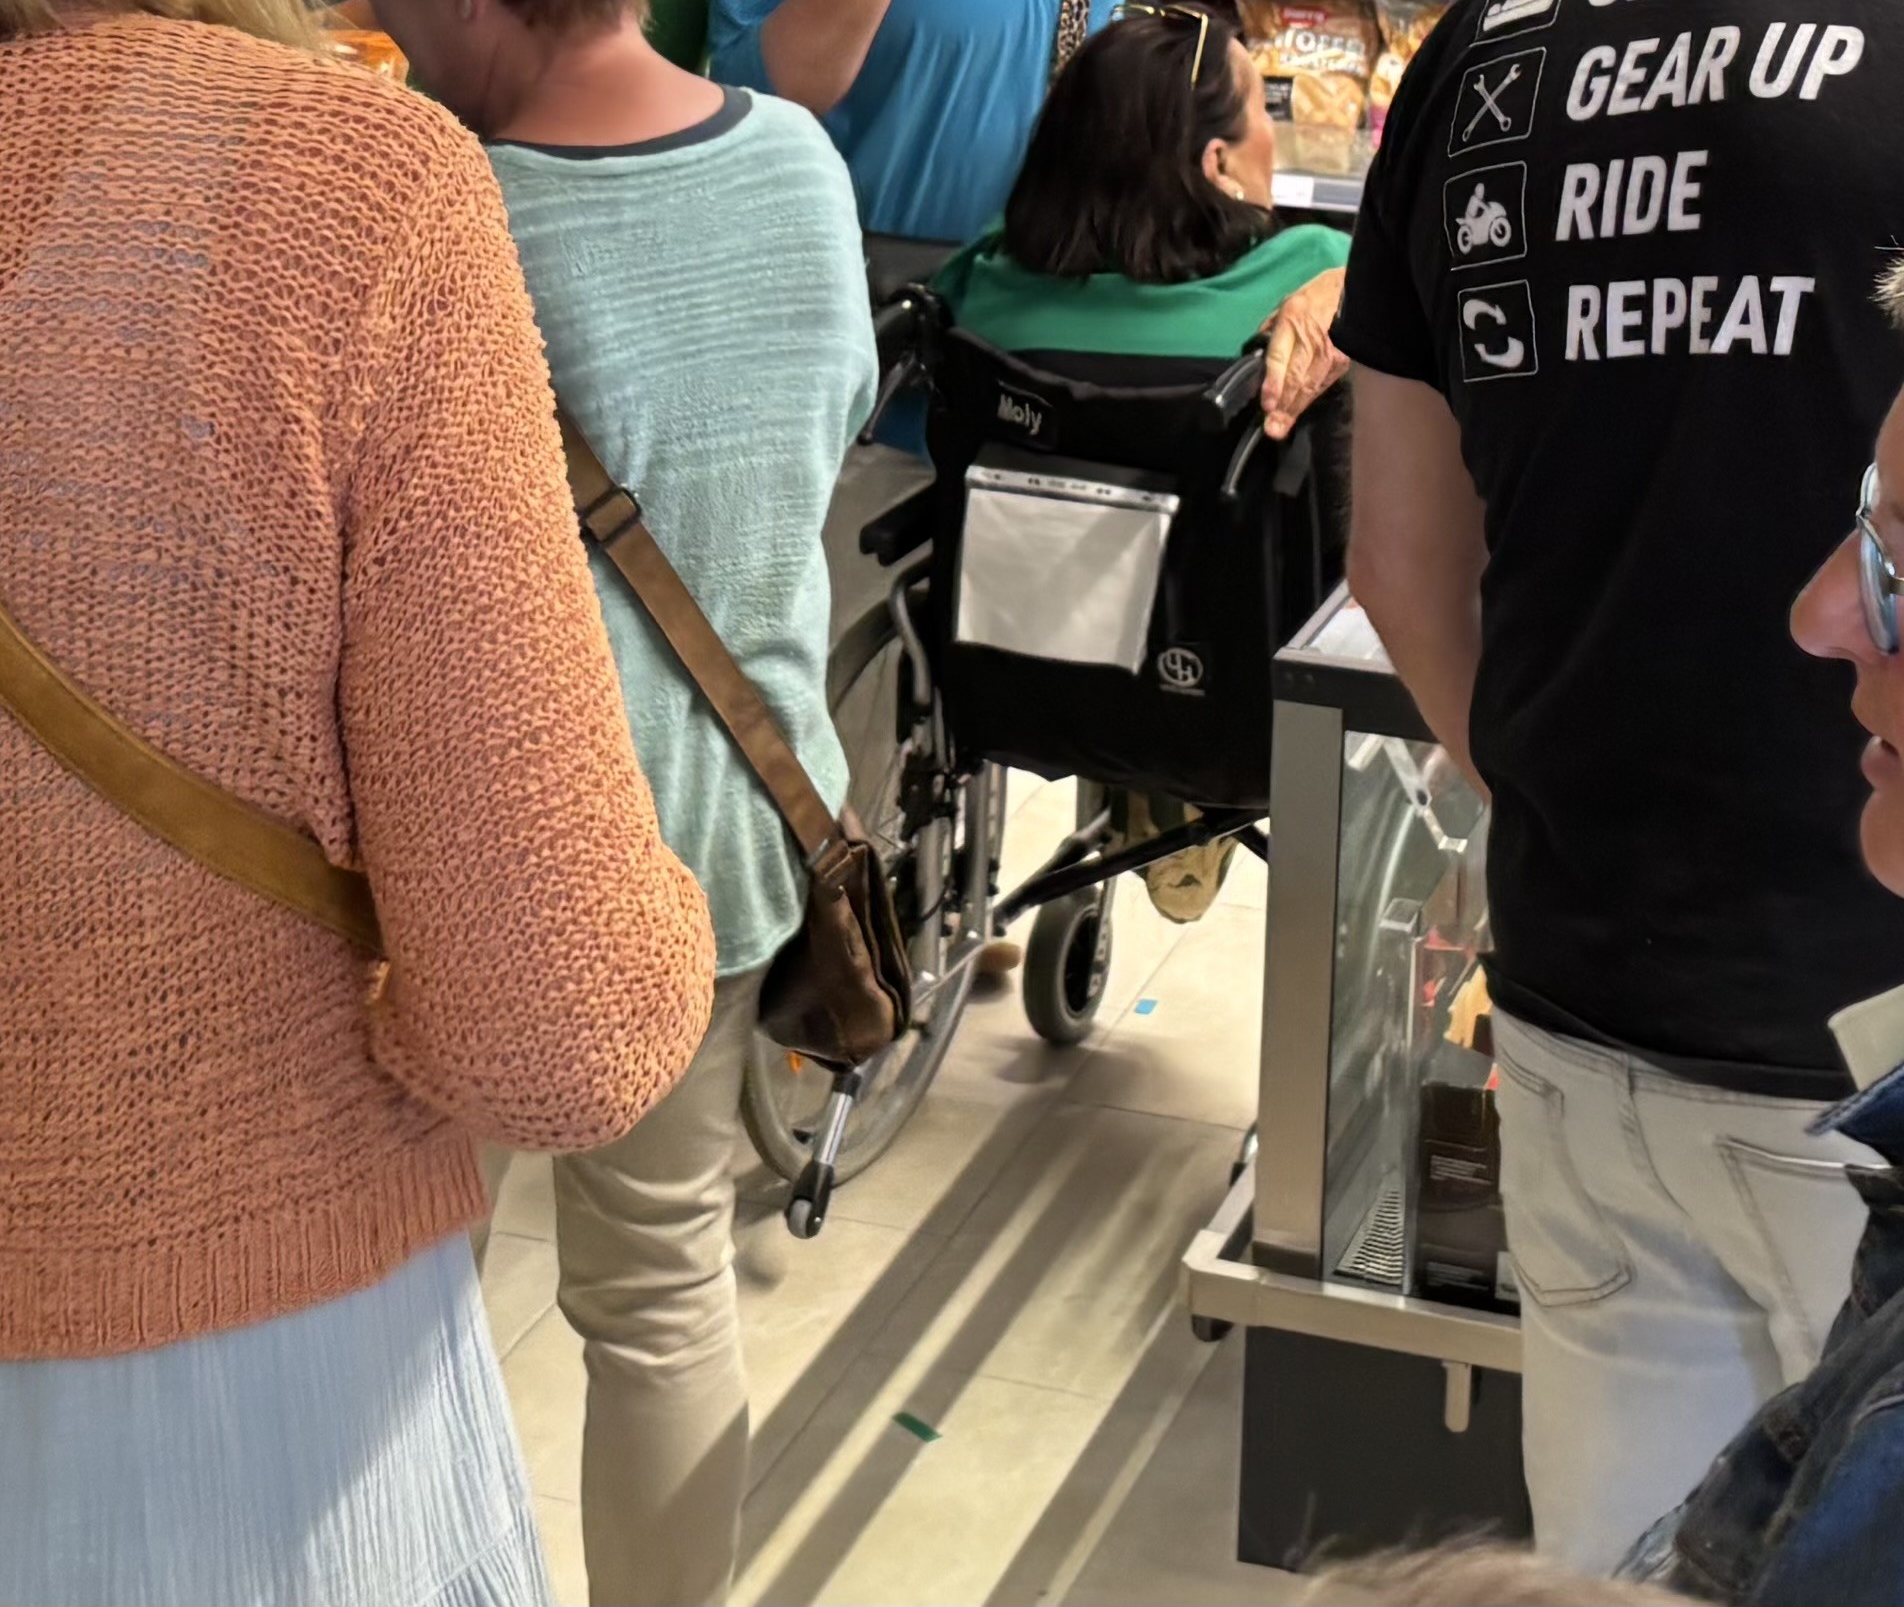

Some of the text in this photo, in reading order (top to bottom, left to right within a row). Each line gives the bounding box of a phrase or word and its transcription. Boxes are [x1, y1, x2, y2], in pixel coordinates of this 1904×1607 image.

[1566, 22, 1865, 122] GEAR UP
[1555, 150, 1708, 242] RIDE
[1564, 275, 1815, 362] REPEAT
